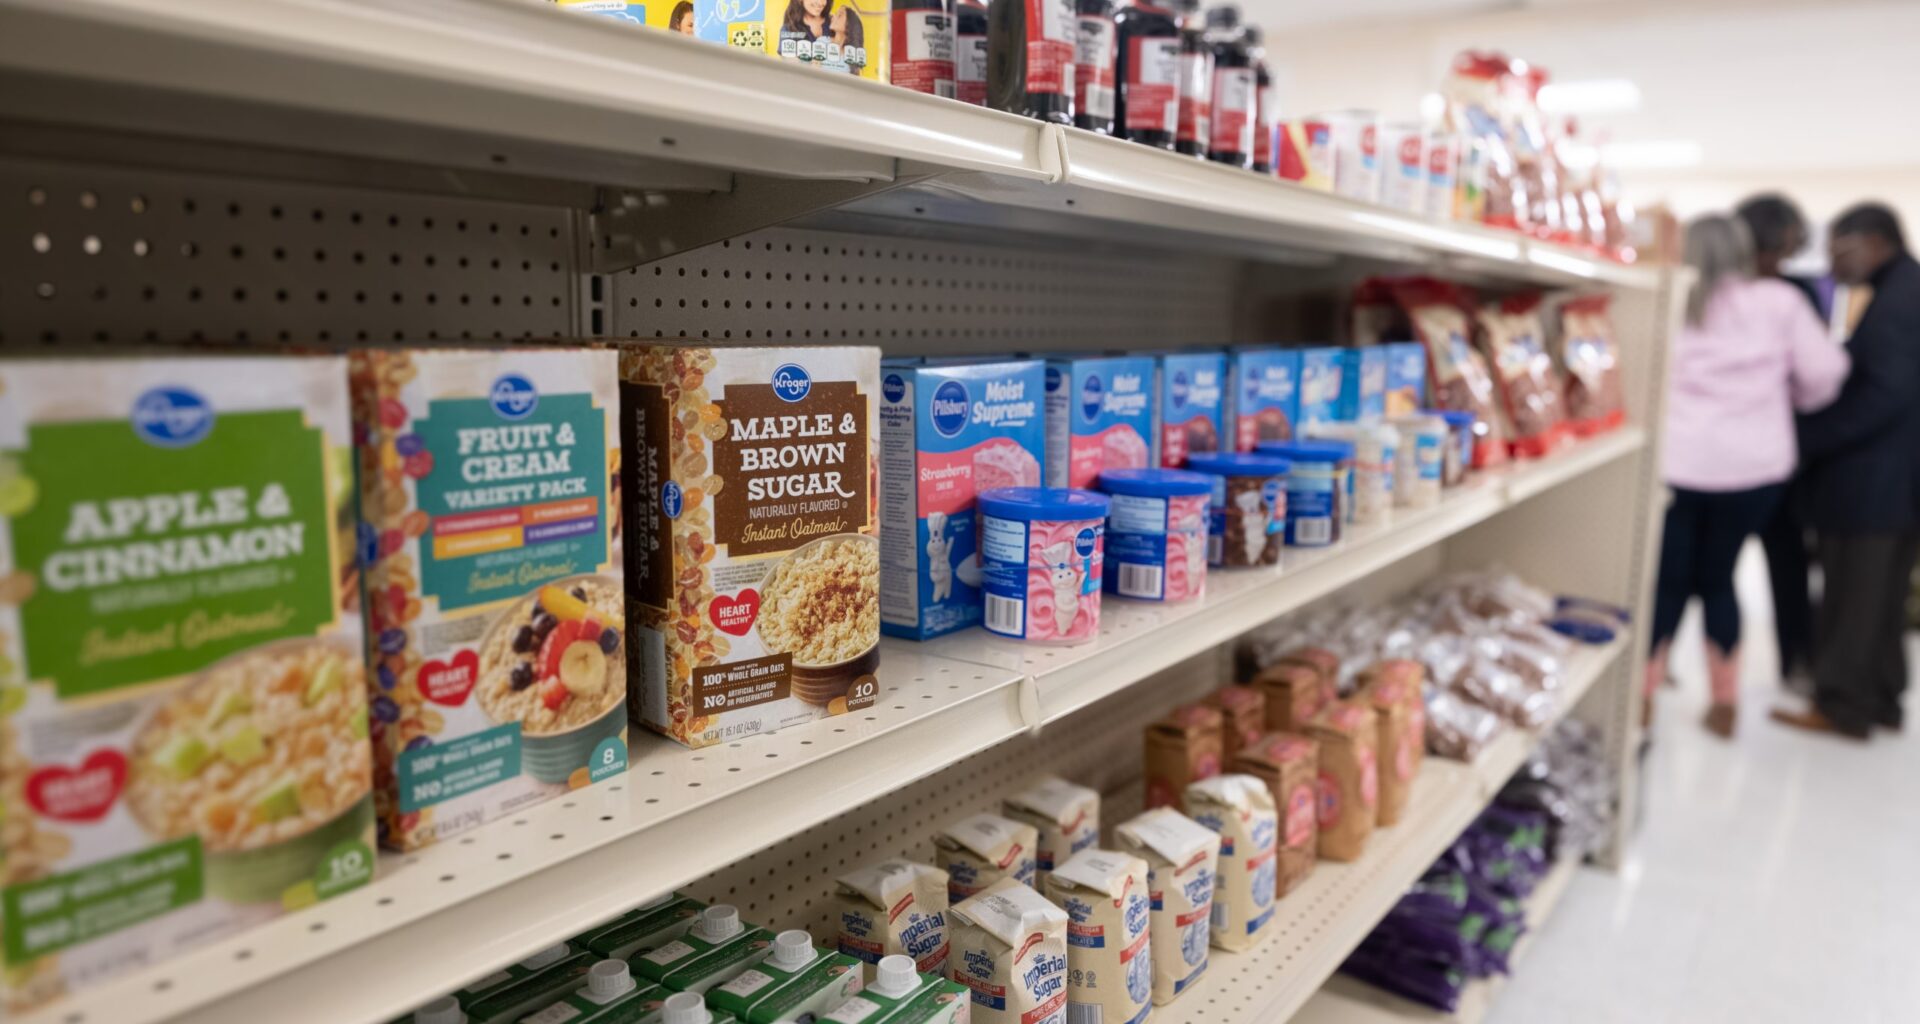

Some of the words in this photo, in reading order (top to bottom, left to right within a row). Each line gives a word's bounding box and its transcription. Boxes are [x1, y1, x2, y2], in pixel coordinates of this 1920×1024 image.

[783, 41, 795, 50] 150
[775, 372, 809, 394] Kroger
[985, 379, 1025, 403] Moist
[934, 399, 967, 418] Pillsbury
[972, 400, 1036, 427] Supreme
[457, 423, 553, 456] FRUIT
[555, 421, 577, 447] &
[730, 413, 833, 442] MAPLE
[838, 412, 857, 435] &
[636, 407, 647, 496] BROWN
[740, 442, 847, 471] BROWN
[461, 449, 572, 484] CREAM
[920, 463, 972, 482] Strawberry
[444, 482, 535, 510] VARIETY
[537, 476, 588, 499] PACK
[647, 446, 660, 531] MAPLE
[747, 471, 857, 501] SUGAR
[65, 487, 248, 544] APPLE
[254, 481, 293, 519] &
[749, 503, 798, 520] NATURALLY
[800, 499, 840, 514] FLAVORED
[741, 522, 787, 544] Instant
[790, 516, 848, 540] Oatmeal
[43, 522, 305, 592] CINNAMON
[638, 502, 650, 589] SUGAR
[719, 603, 752, 619] HEART
[720, 616, 749, 627] HEALTHY
[703, 671, 726, 687] 100%
[727, 669, 749, 682] WHOLE
[750, 666, 769, 678] GRAIN
[770, 663, 785, 674] OATS
[727, 685, 755, 698] ARTIFICIAL
[755, 681, 777, 691] FLAVORS
[727, 697, 736, 707] OR
[735, 690, 774, 704] PRESERVATIVES
[855, 682, 873, 698] 10
[603, 748, 615, 765] 8
[330, 850, 363, 881] 10
[841, 911, 873, 930] Imperial
[846, 922, 868, 938] Sugar
[907, 932, 942, 959] Sugar
[963, 950, 995, 972] Imperial
[967, 962, 991, 980] Sugar
[1023, 954, 1067, 990] Imperial
[1033, 976, 1062, 1002] Sugar
